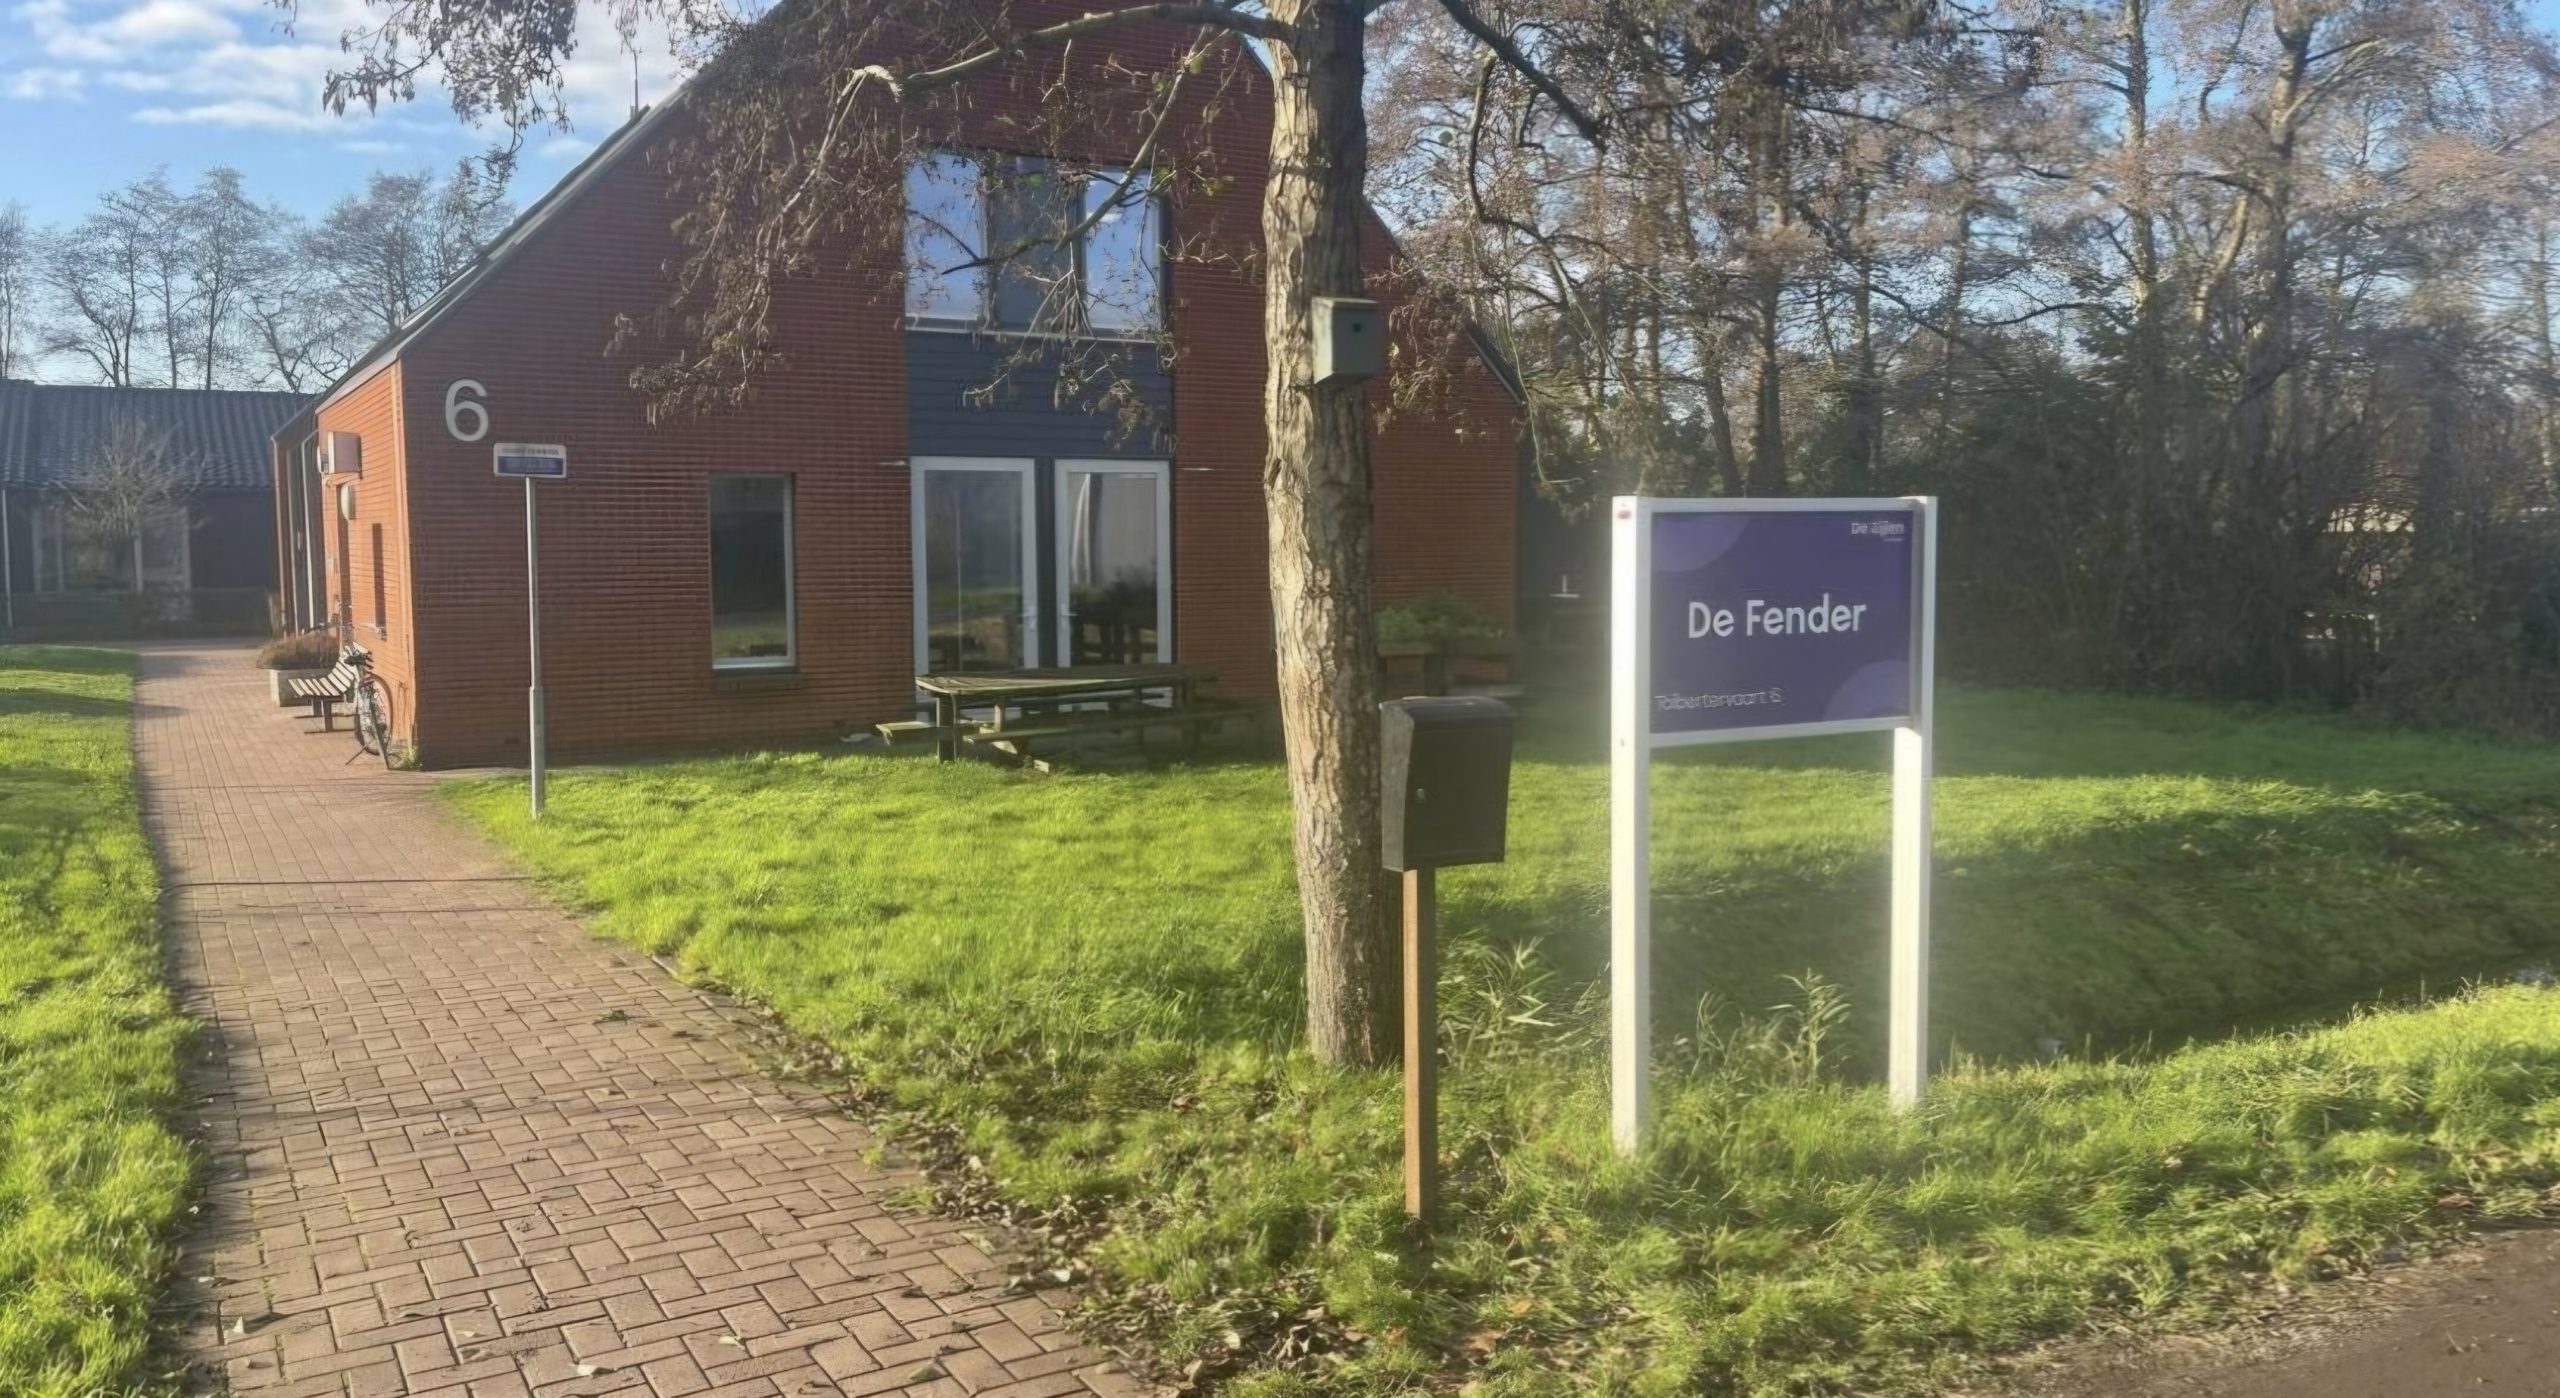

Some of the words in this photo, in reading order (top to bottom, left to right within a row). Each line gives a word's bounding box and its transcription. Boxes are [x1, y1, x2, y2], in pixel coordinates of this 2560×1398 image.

[445, 378, 489, 442] 6
[1851, 522, 1868, 535] De
[1688, 601, 1735, 638] De
[1746, 593, 1868, 636] Fender
